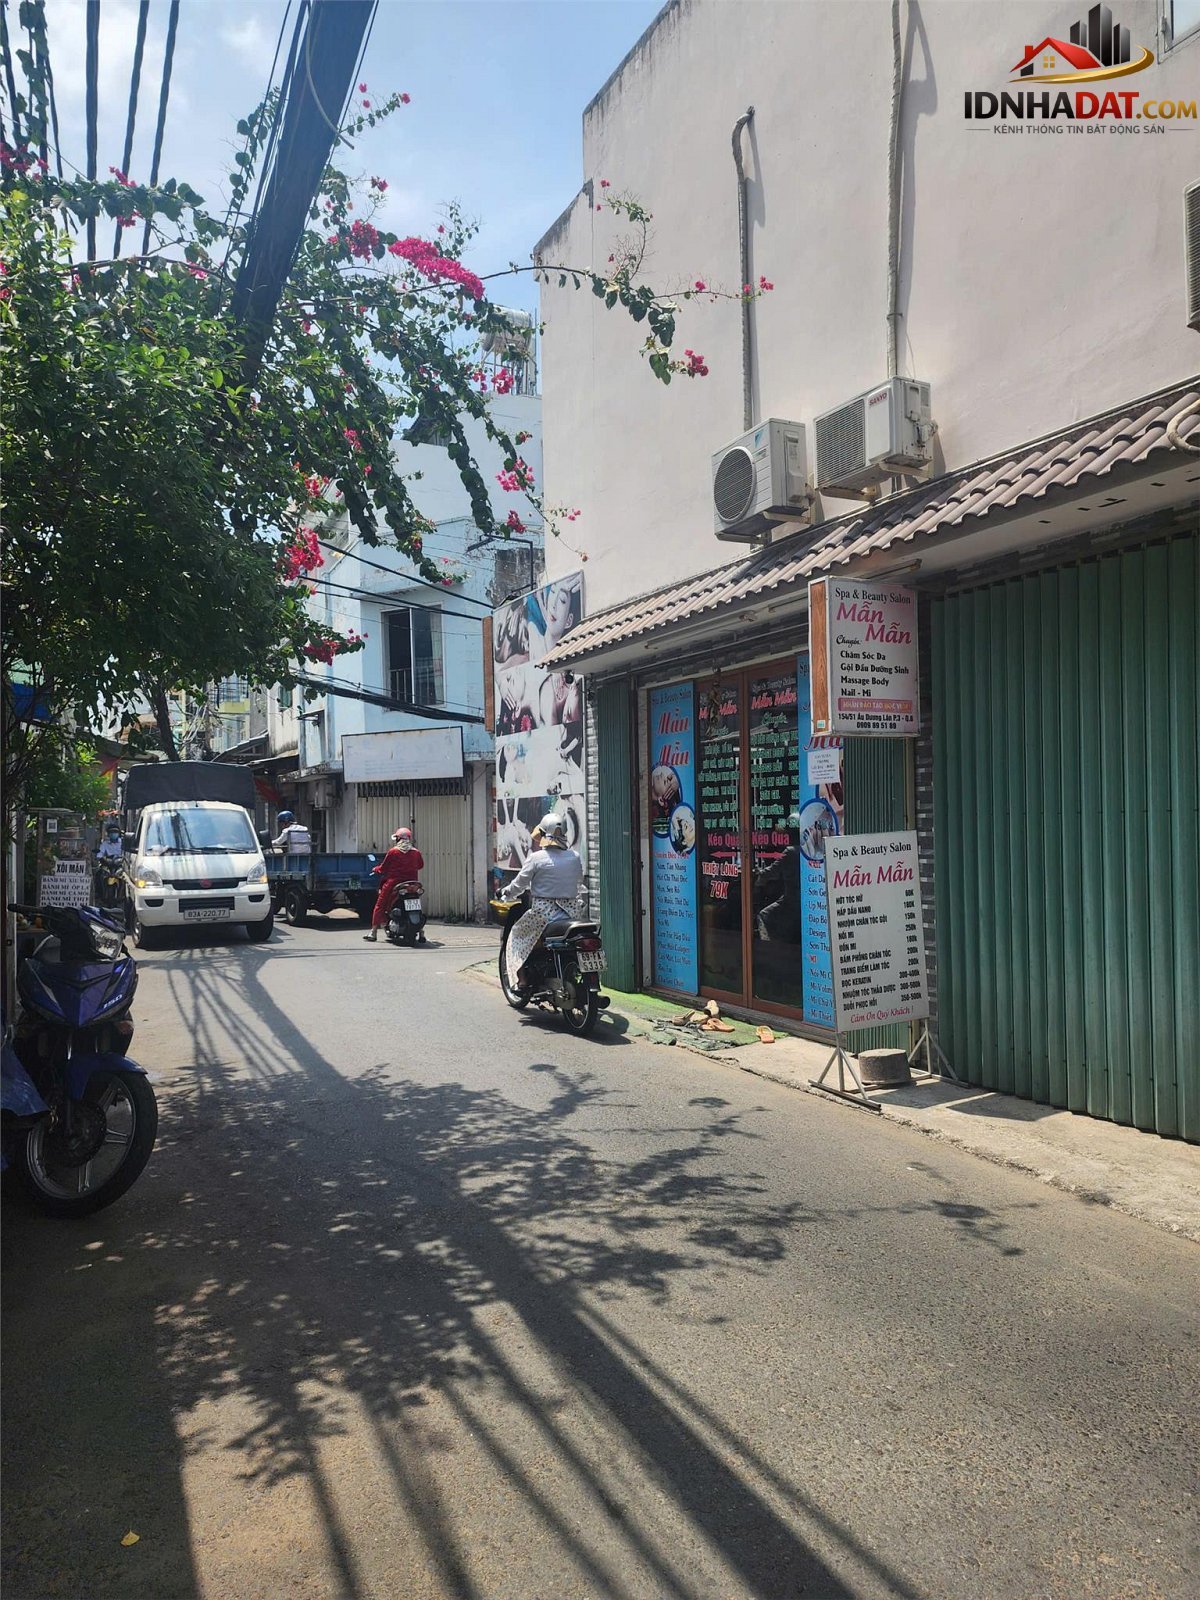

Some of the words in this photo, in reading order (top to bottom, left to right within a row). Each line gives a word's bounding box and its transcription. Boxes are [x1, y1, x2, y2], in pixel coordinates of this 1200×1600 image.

[835, 587, 850, 600] Spa
[852, 589, 860, 599] &
[862, 590, 888, 604] Beauty
[890, 593, 911, 604] Salon
[836, 601, 885, 623] Mẫn
[865, 622, 912, 644] Mẫn
[840, 650, 860, 659] Chăm
[862, 651, 874, 660] Sóc
[876, 652, 886, 661] Da
[841, 663, 853, 672] Gội
[871, 664, 893, 675] Dưỡng
[894, 666, 909, 674] Sinh
[841, 676, 870, 686] Massage
[872, 677, 889, 687] Body
[841, 688, 856, 697] Nail
[862, 689, 871, 697] Mi
[708, 832, 723, 846] Kéo
[751, 831, 768, 845] Kéo
[771, 831, 790, 846] Qua
[833, 847, 849, 860] Spa
[851, 846, 858, 856] &
[860, 844, 888, 856] Beauty
[890, 842, 911, 853] Salon
[56, 861, 68, 873] XÔI
[720, 860, 738, 877] LÔNG
[833, 864, 872, 888] Mẫn
[876, 861, 914, 884] Mẫn
[710, 880, 729, 900] 79K
[882, 949, 891, 957] TÓC
[841, 966, 856, 976] TRANG
[881, 961, 890, 970] TÓC
[861, 987, 870, 997] TÓC
[890, 1006, 910, 1017] Khách
